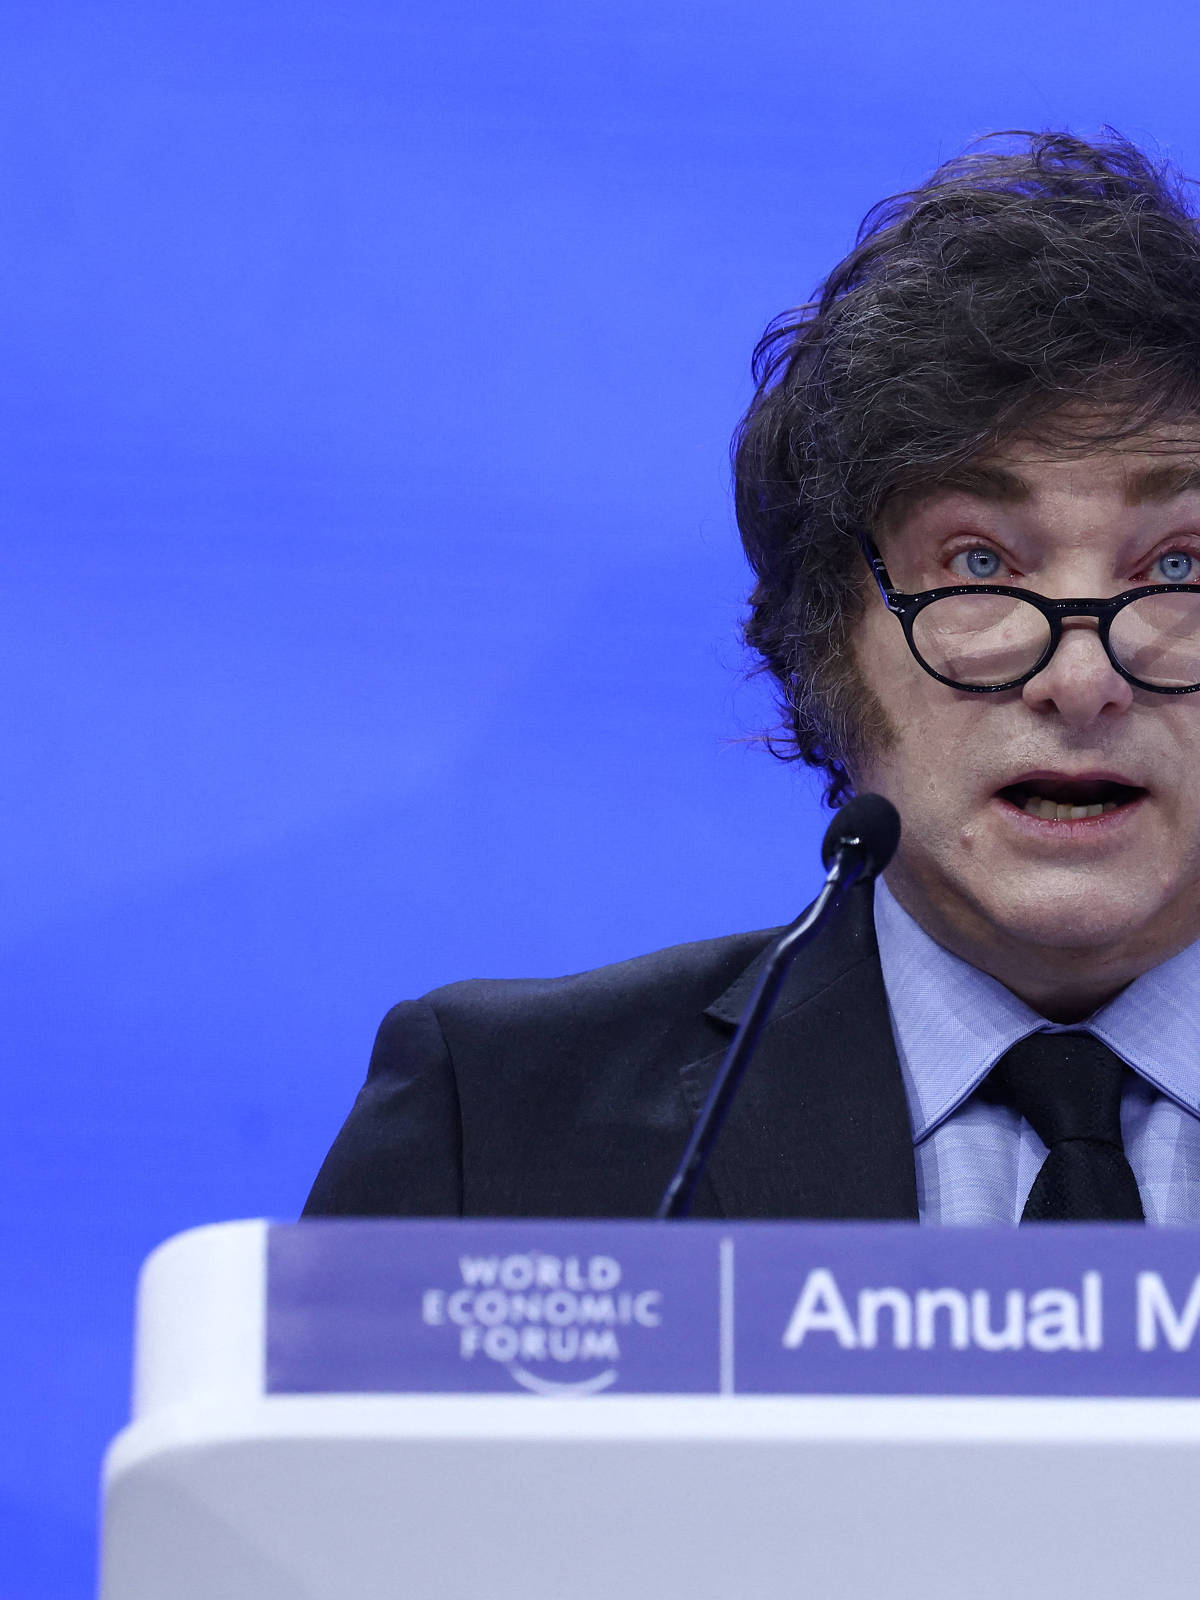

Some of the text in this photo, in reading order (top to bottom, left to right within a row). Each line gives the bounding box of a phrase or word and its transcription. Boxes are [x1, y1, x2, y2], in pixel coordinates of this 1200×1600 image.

[458, 1254, 621, 1291] WORLD
[422, 1289, 662, 1327] ECONOMIC
[783, 1268, 1102, 1351] Annual
[459, 1325, 621, 1363] FORUM
